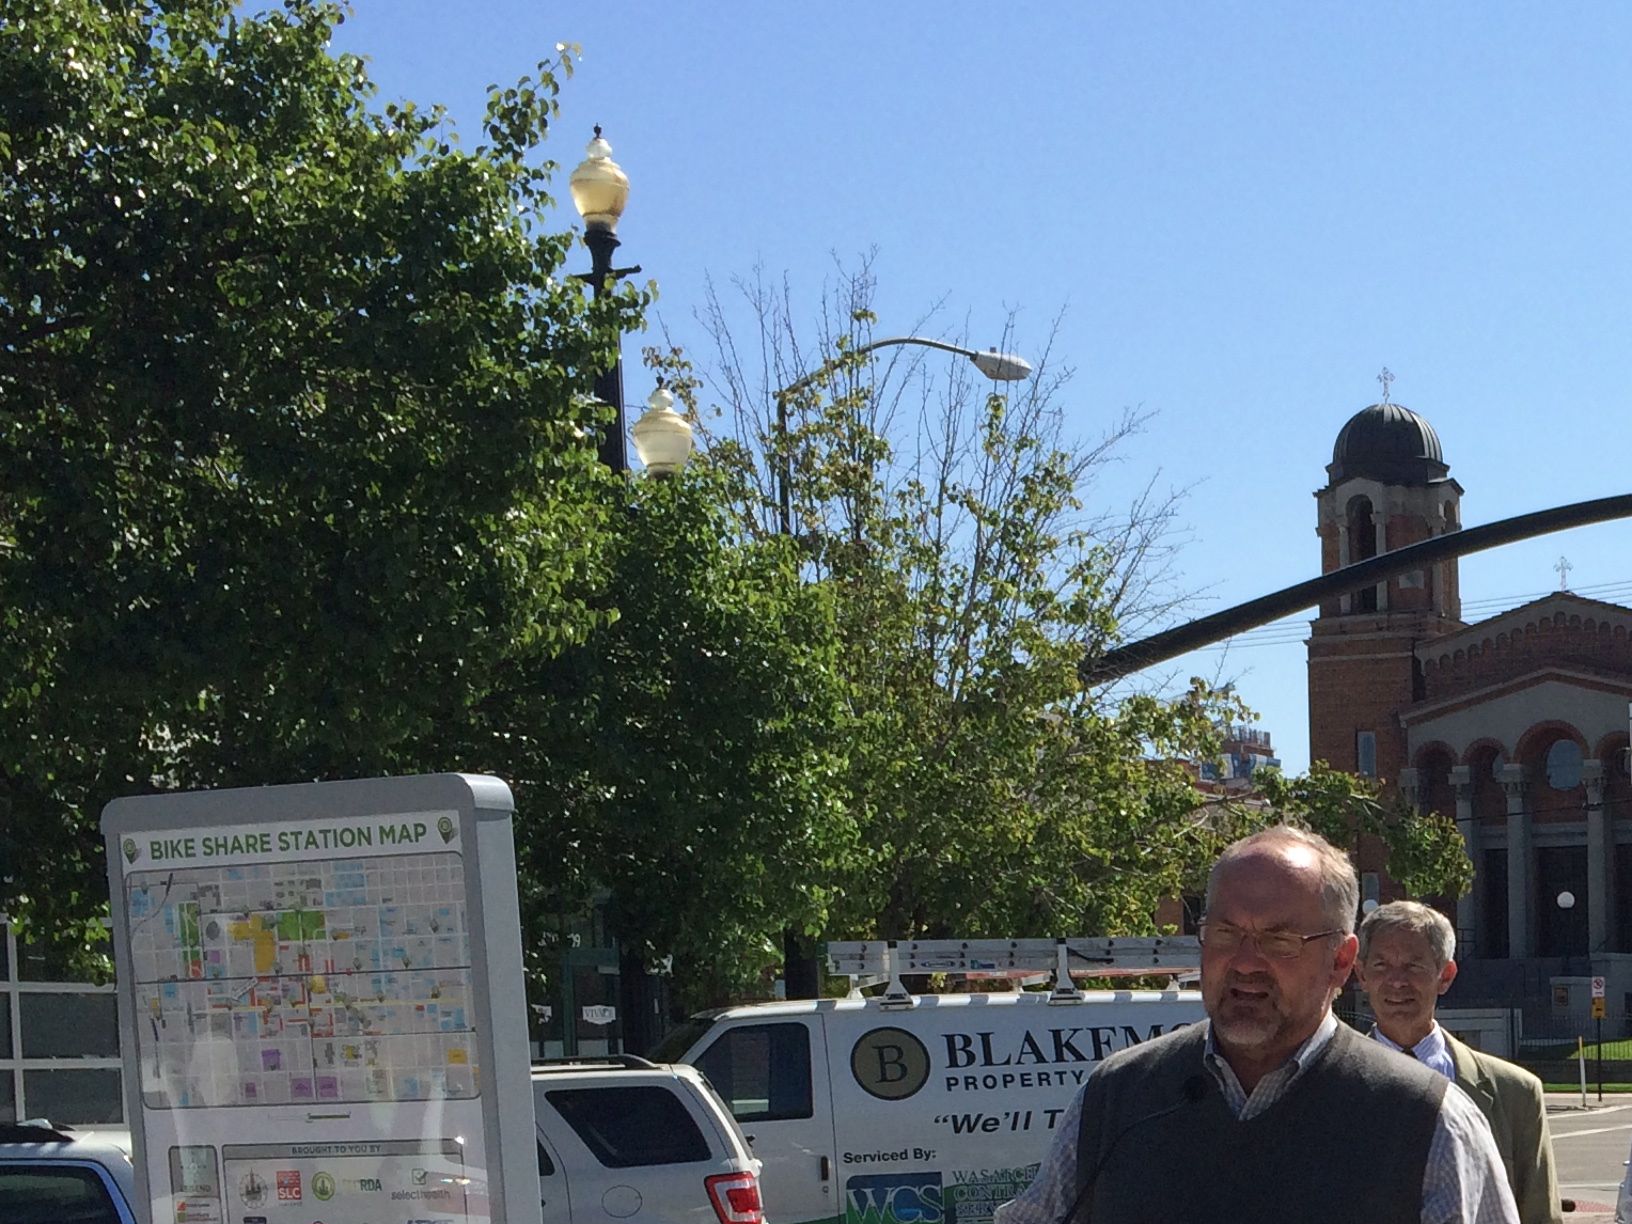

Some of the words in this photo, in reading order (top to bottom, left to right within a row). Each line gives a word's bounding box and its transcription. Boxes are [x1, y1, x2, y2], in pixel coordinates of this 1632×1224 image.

[149, 837, 196, 860] BIKE
[202, 832, 273, 857] SHARE
[278, 825, 373, 852] STATION
[379, 821, 428, 846] MAP
[872, 1044, 909, 1084] B
[945, 1069, 1085, 1092] PROPERTY
[291, 1146, 332, 1155] BROUGHT
[335, 1145, 347, 1153] TO
[348, 1145, 368, 1153] YOU
[369, 1144, 382, 1153] BY
[842, 1150, 909, 1164] Serviced
[913, 1148, 937, 1163] By:
[278, 1187, 301, 1199] SLC
[360, 1178, 382, 1192] RDA
